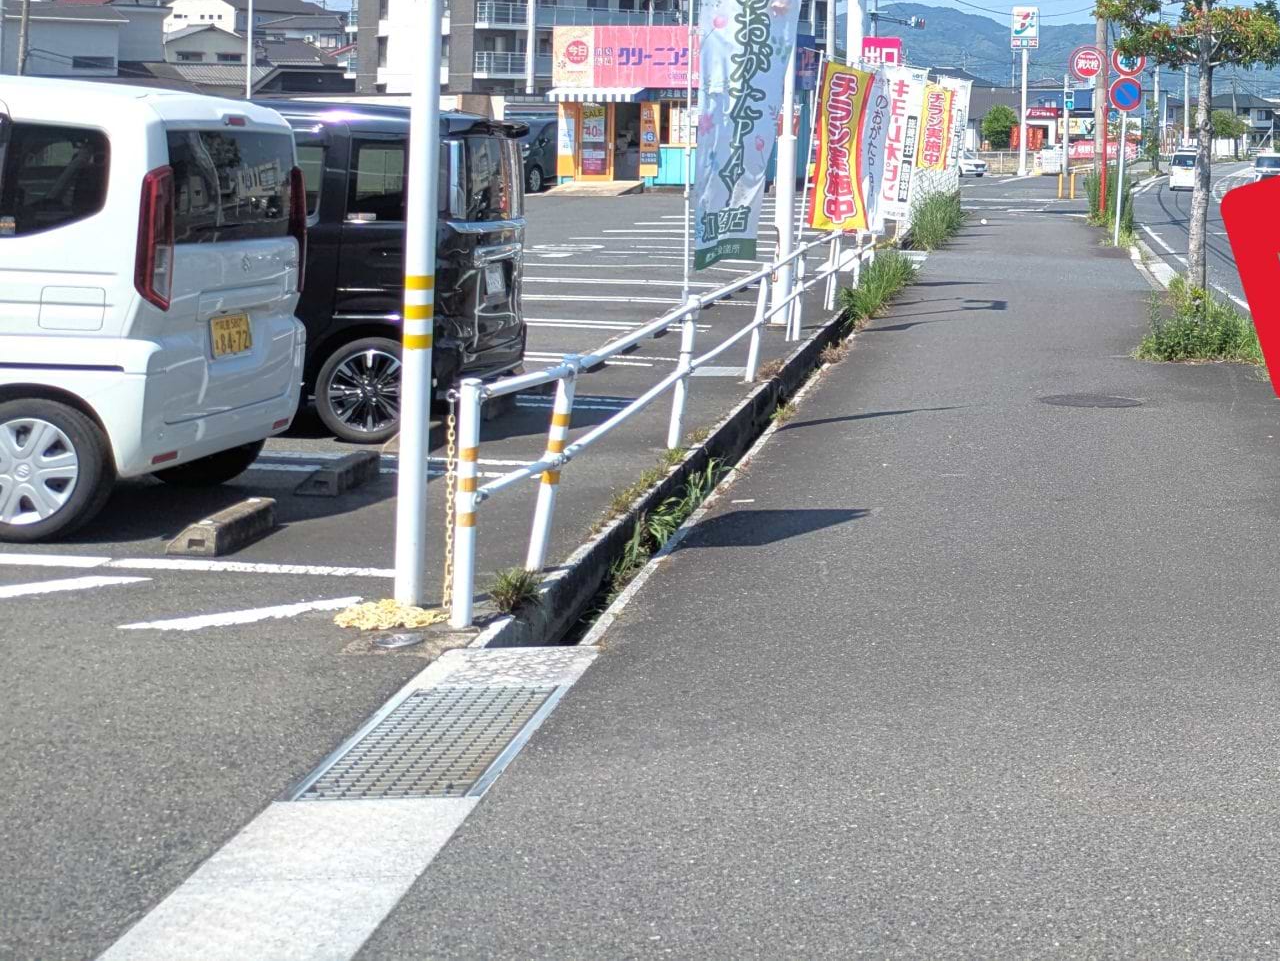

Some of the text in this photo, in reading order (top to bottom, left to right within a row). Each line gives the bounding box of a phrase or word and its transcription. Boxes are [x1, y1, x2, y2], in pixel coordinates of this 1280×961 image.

[864, 46, 898, 65] 出口
[1077, 59, 1099, 70] 消火栓
